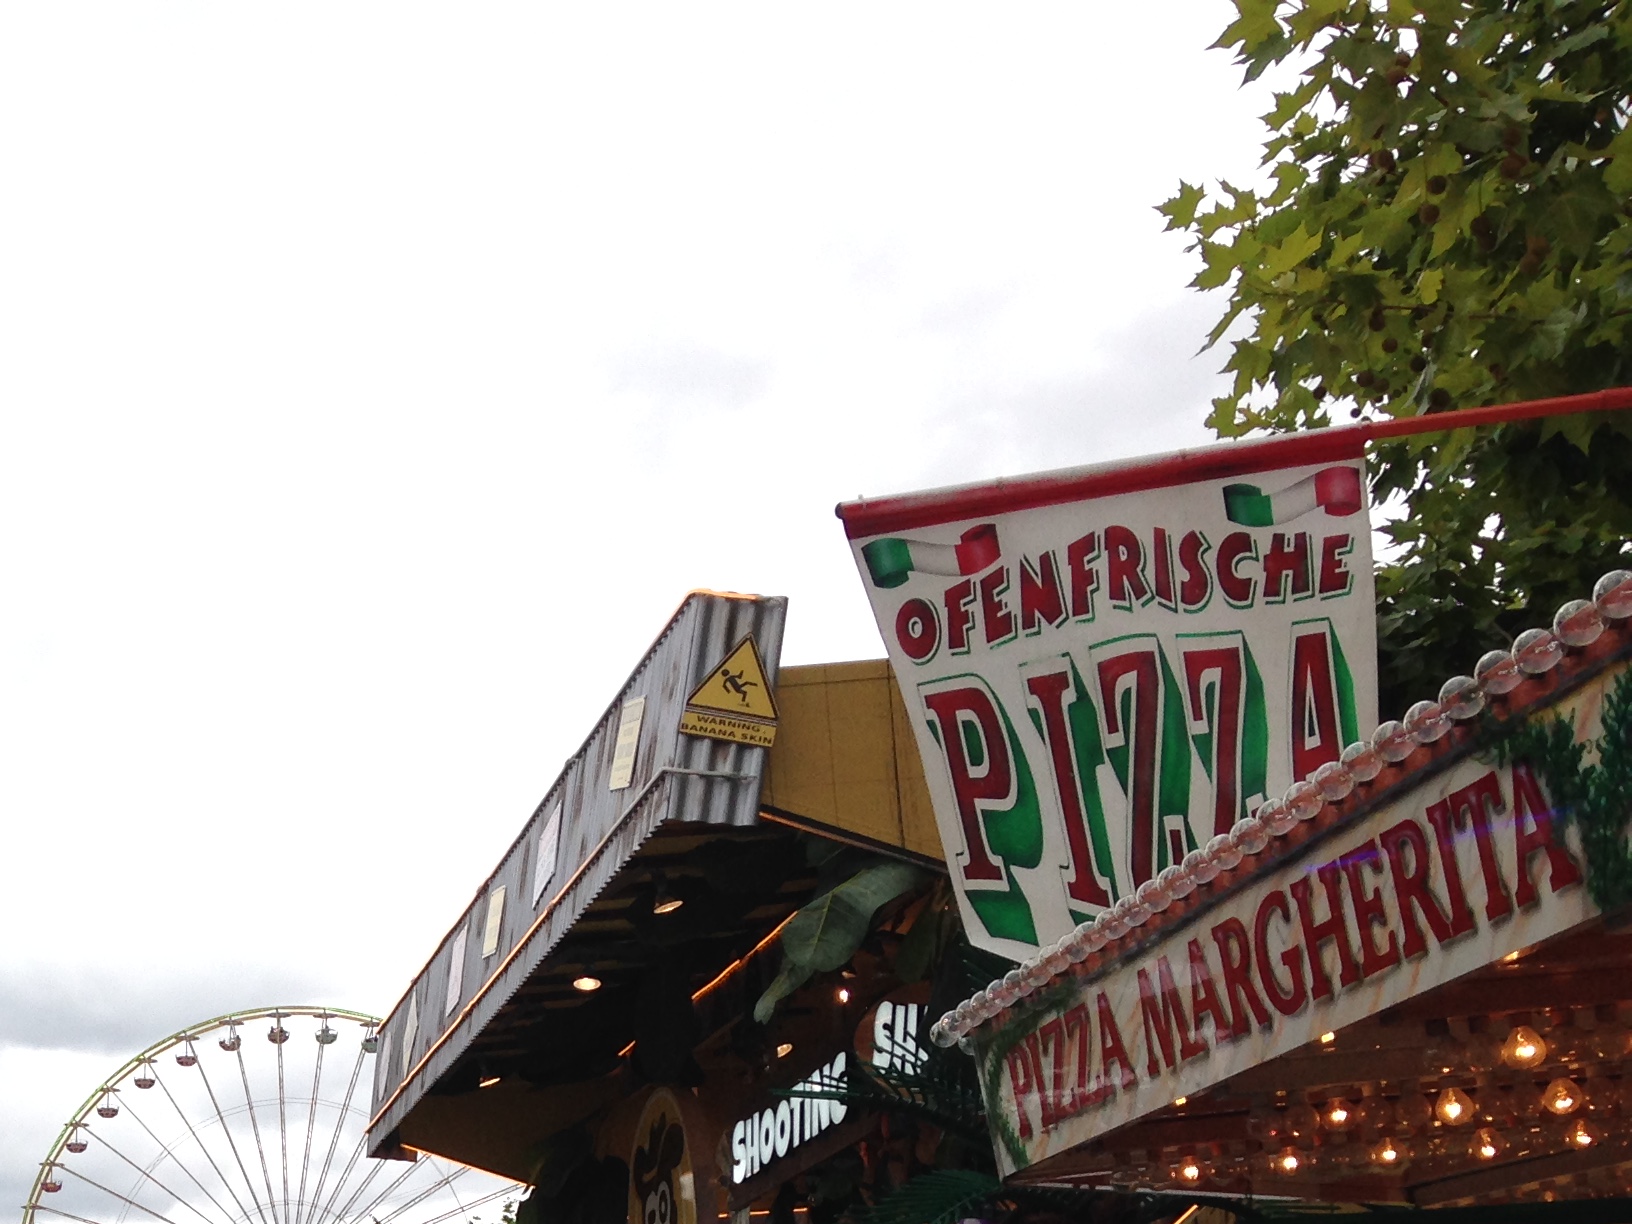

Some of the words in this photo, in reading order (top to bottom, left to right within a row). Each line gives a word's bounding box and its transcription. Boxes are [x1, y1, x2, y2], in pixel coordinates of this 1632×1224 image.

[895, 526, 1355, 664] OFENFRISCHE
[681, 722, 736, 739] BANANA
[741, 732, 773, 745] SKIN
[697, 714, 761, 733] WARNING
[922, 622, 1356, 908] PIZZA
[1005, 992, 1133, 1139] PIZZA
[1137, 765, 1584, 1079] MARGHERITA
[732, 1051, 848, 1185] SHOOTING
[872, 1001, 929, 1076] SH
